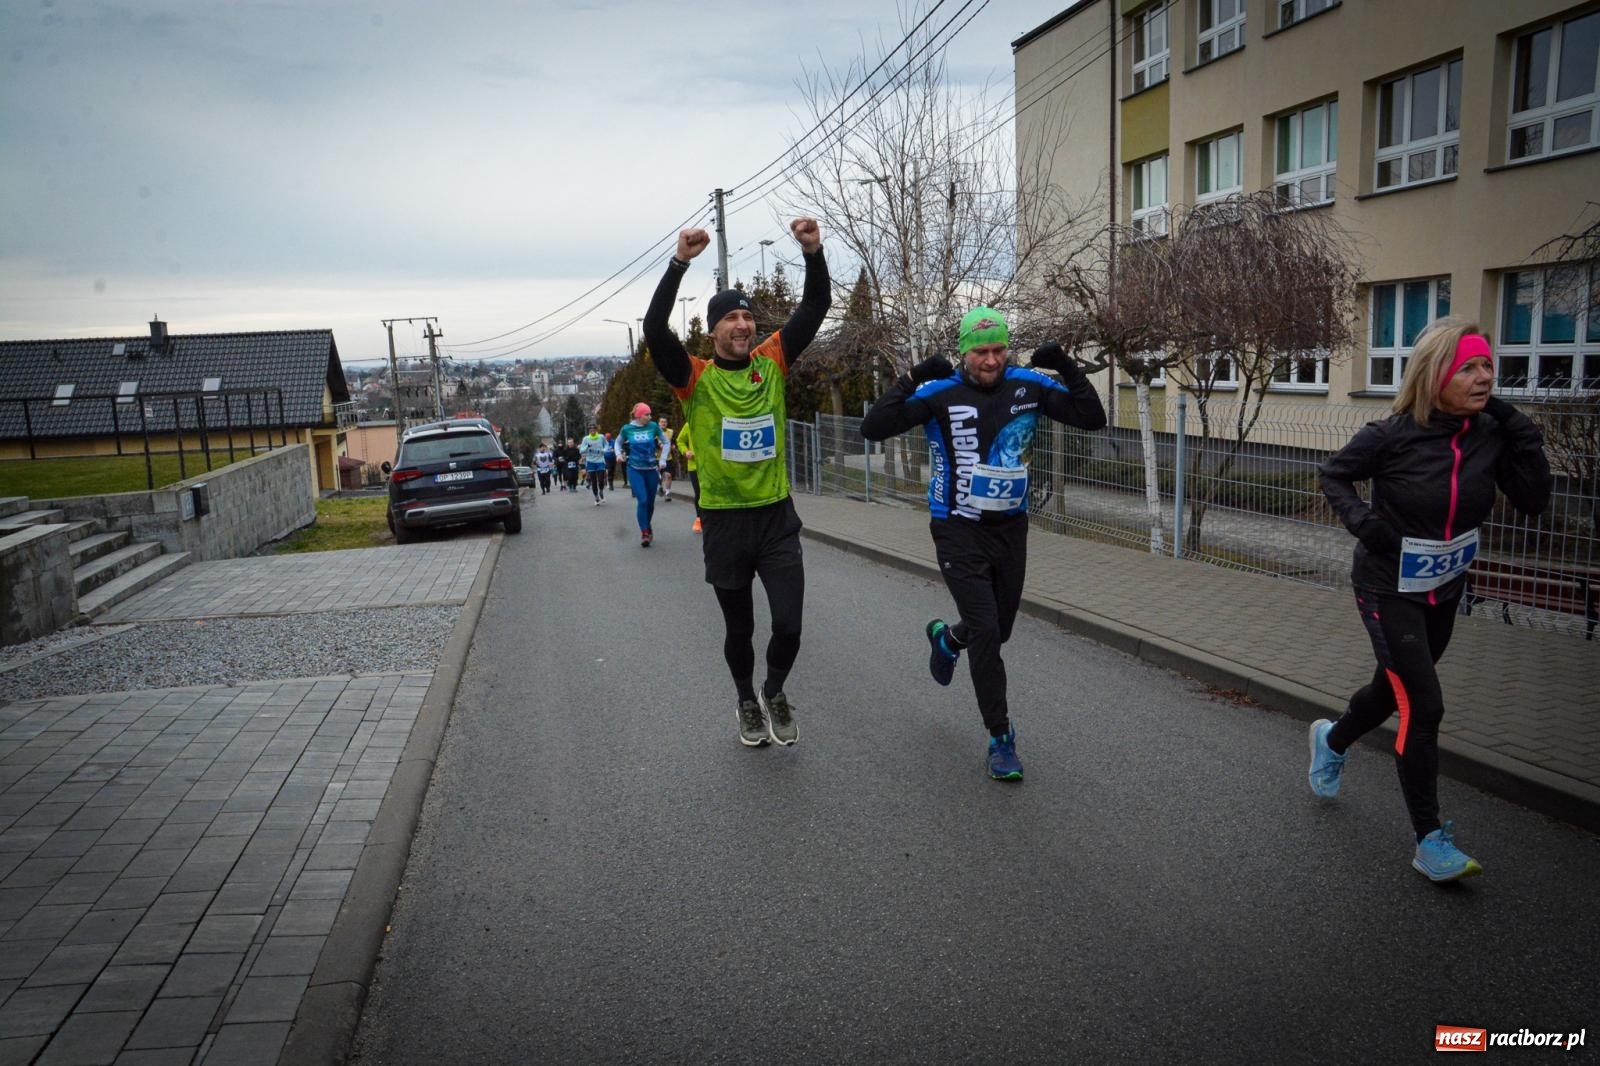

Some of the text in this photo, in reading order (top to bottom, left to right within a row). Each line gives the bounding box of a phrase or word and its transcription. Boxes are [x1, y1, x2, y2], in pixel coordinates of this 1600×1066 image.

[739, 430, 763, 449] 82
[986, 479, 1013, 498] 52
[1415, 548, 1464, 577] 231
